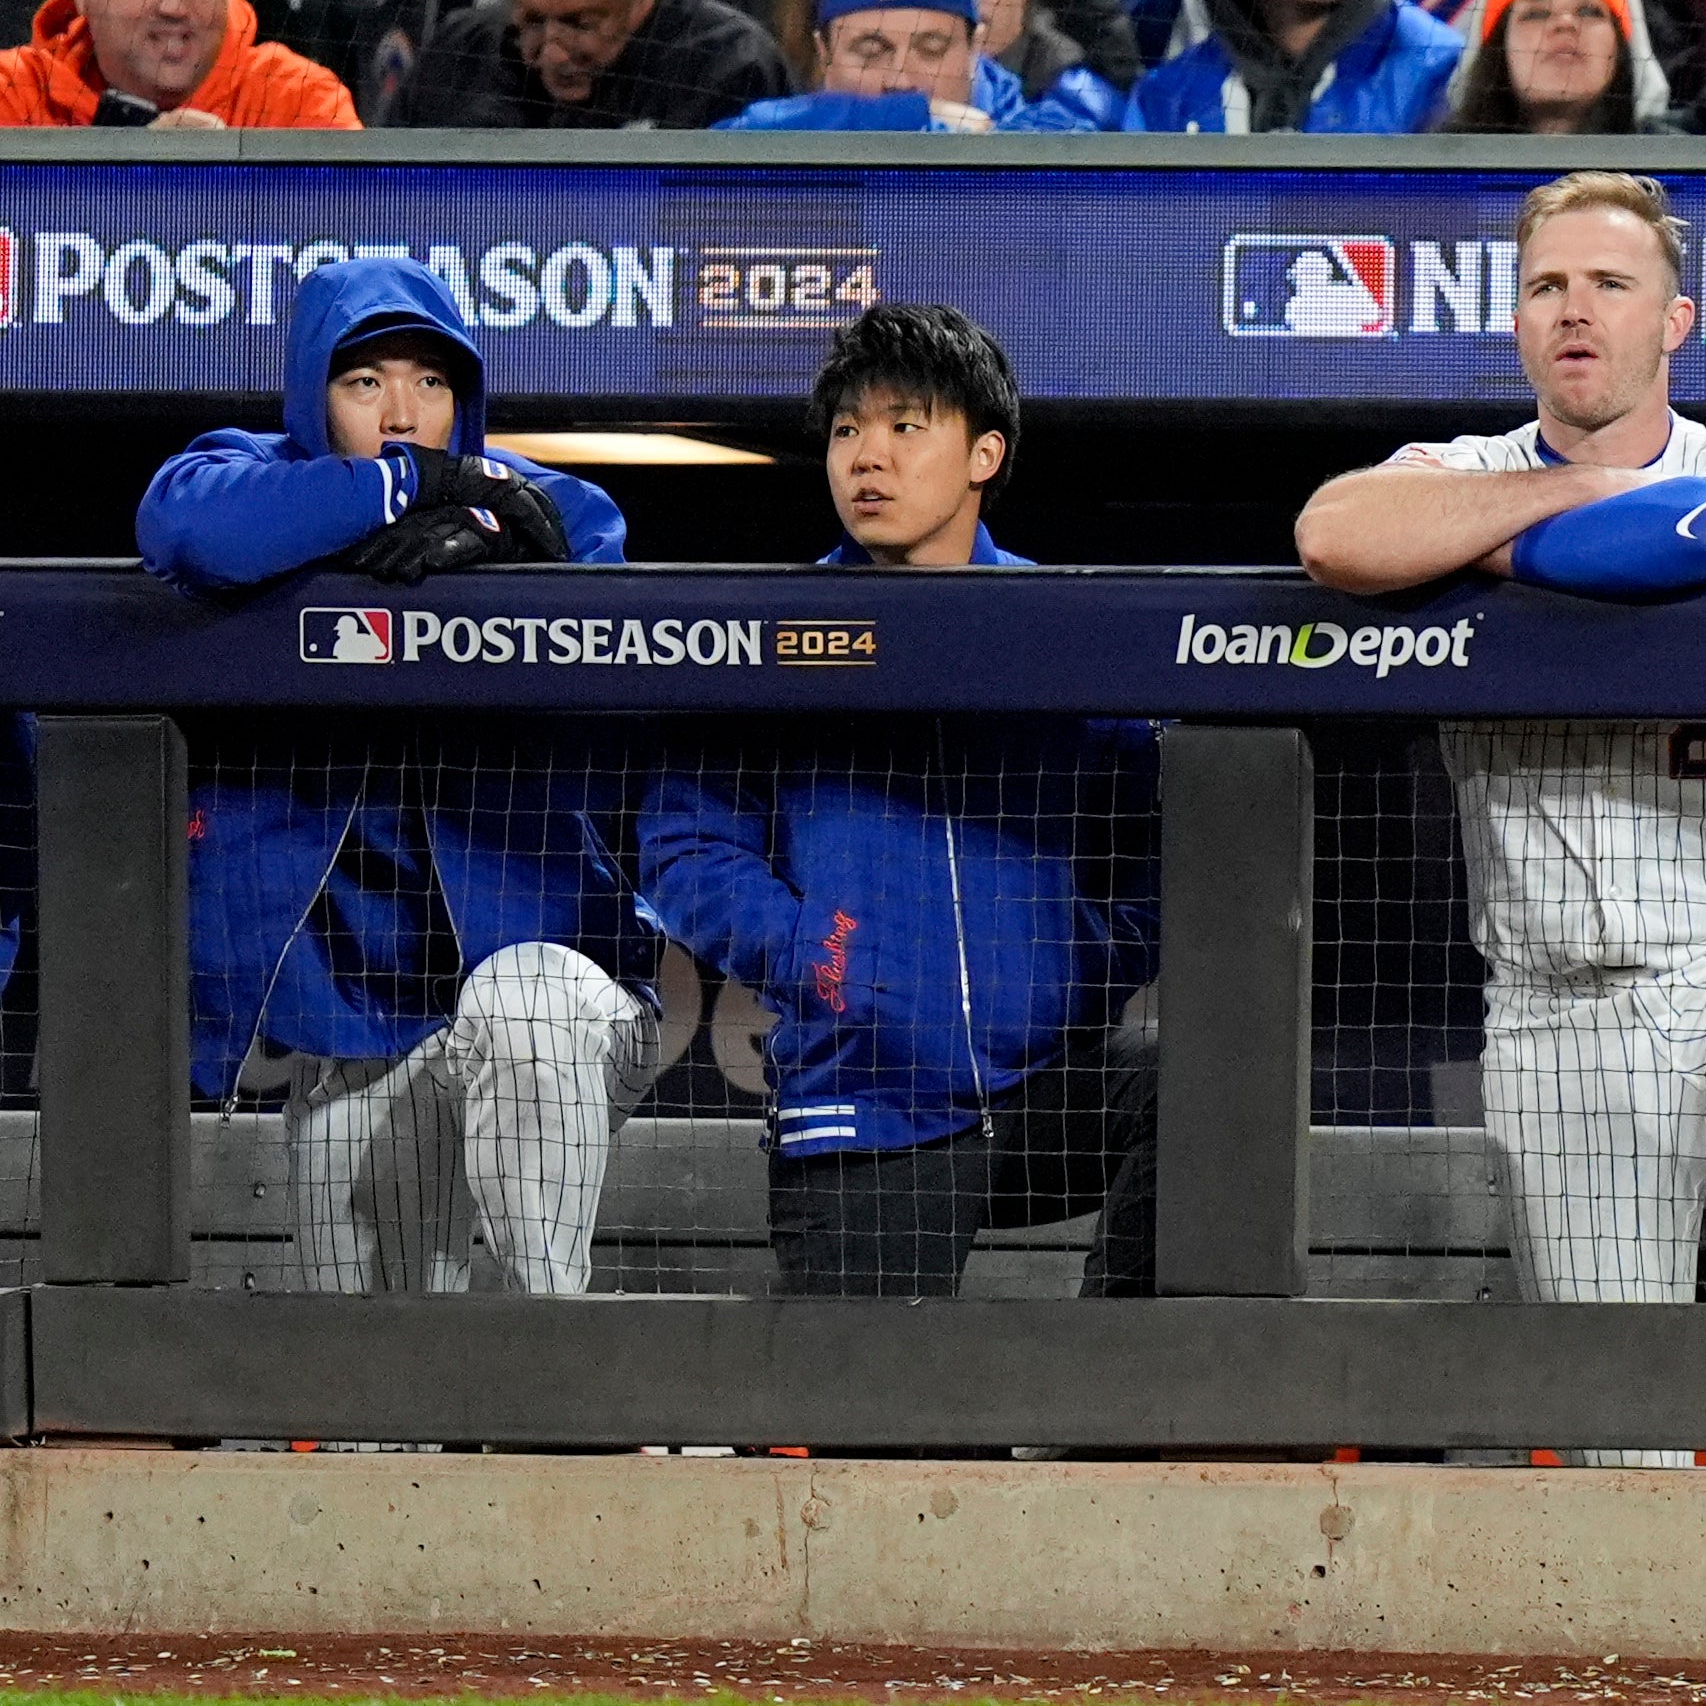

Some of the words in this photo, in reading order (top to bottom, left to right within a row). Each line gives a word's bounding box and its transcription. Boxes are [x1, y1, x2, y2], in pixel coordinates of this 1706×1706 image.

[34, 231, 675, 327] POSTASON
[698, 264, 882, 312] 2024
[402, 610, 764, 666] POSTSEASON
[776, 630, 878, 656] 2024
[1176, 615, 1475, 679] loanDepot
[812, 909, 858, 1013] Flushing
